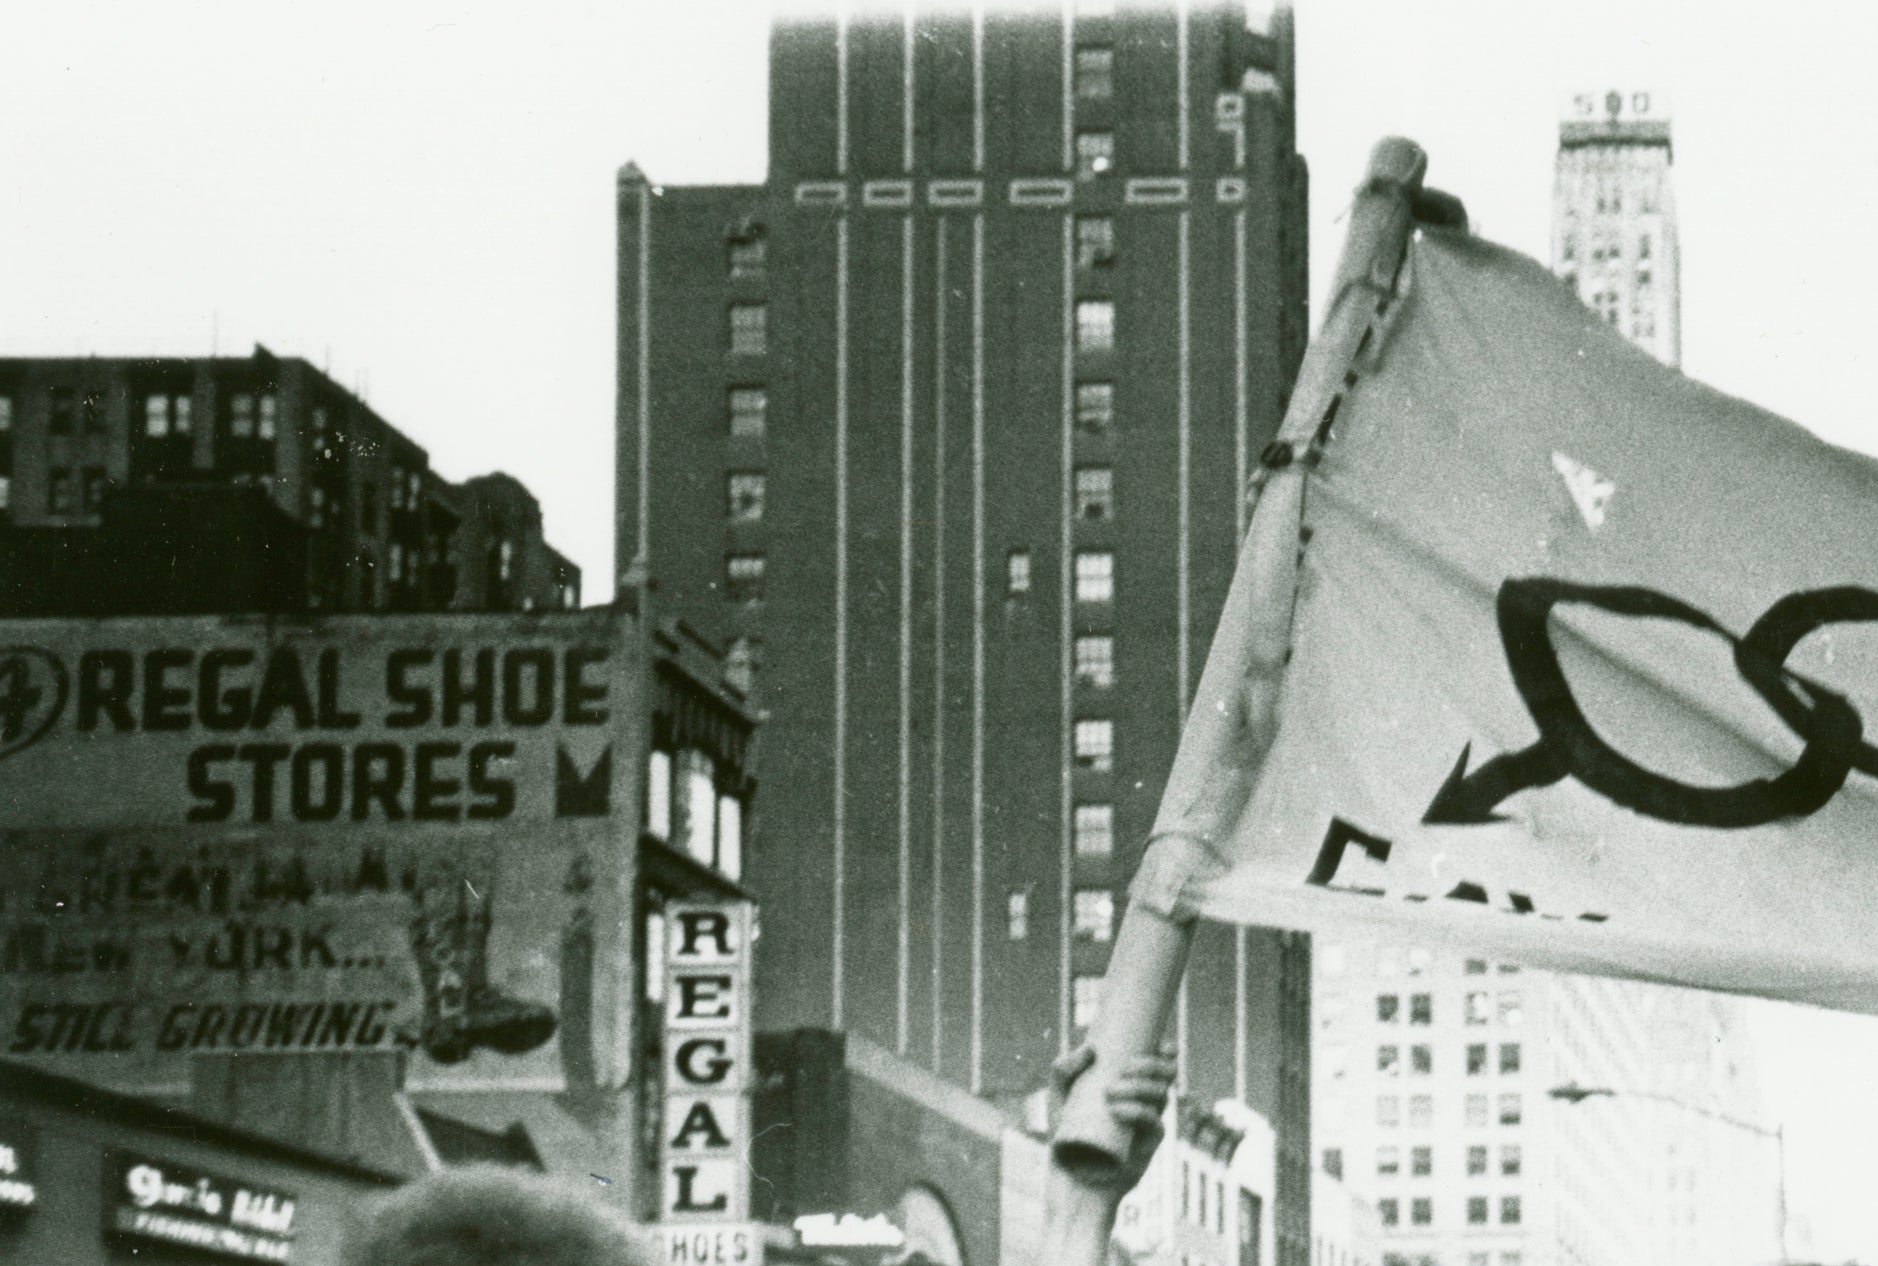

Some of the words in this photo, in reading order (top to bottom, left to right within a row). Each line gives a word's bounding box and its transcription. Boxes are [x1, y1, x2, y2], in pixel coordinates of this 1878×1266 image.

[77, 647, 361, 732] REGAL
[385, 648, 609, 728] SHOE
[186, 743, 516, 822] STORES
[670, 911, 734, 1213] REGAL
